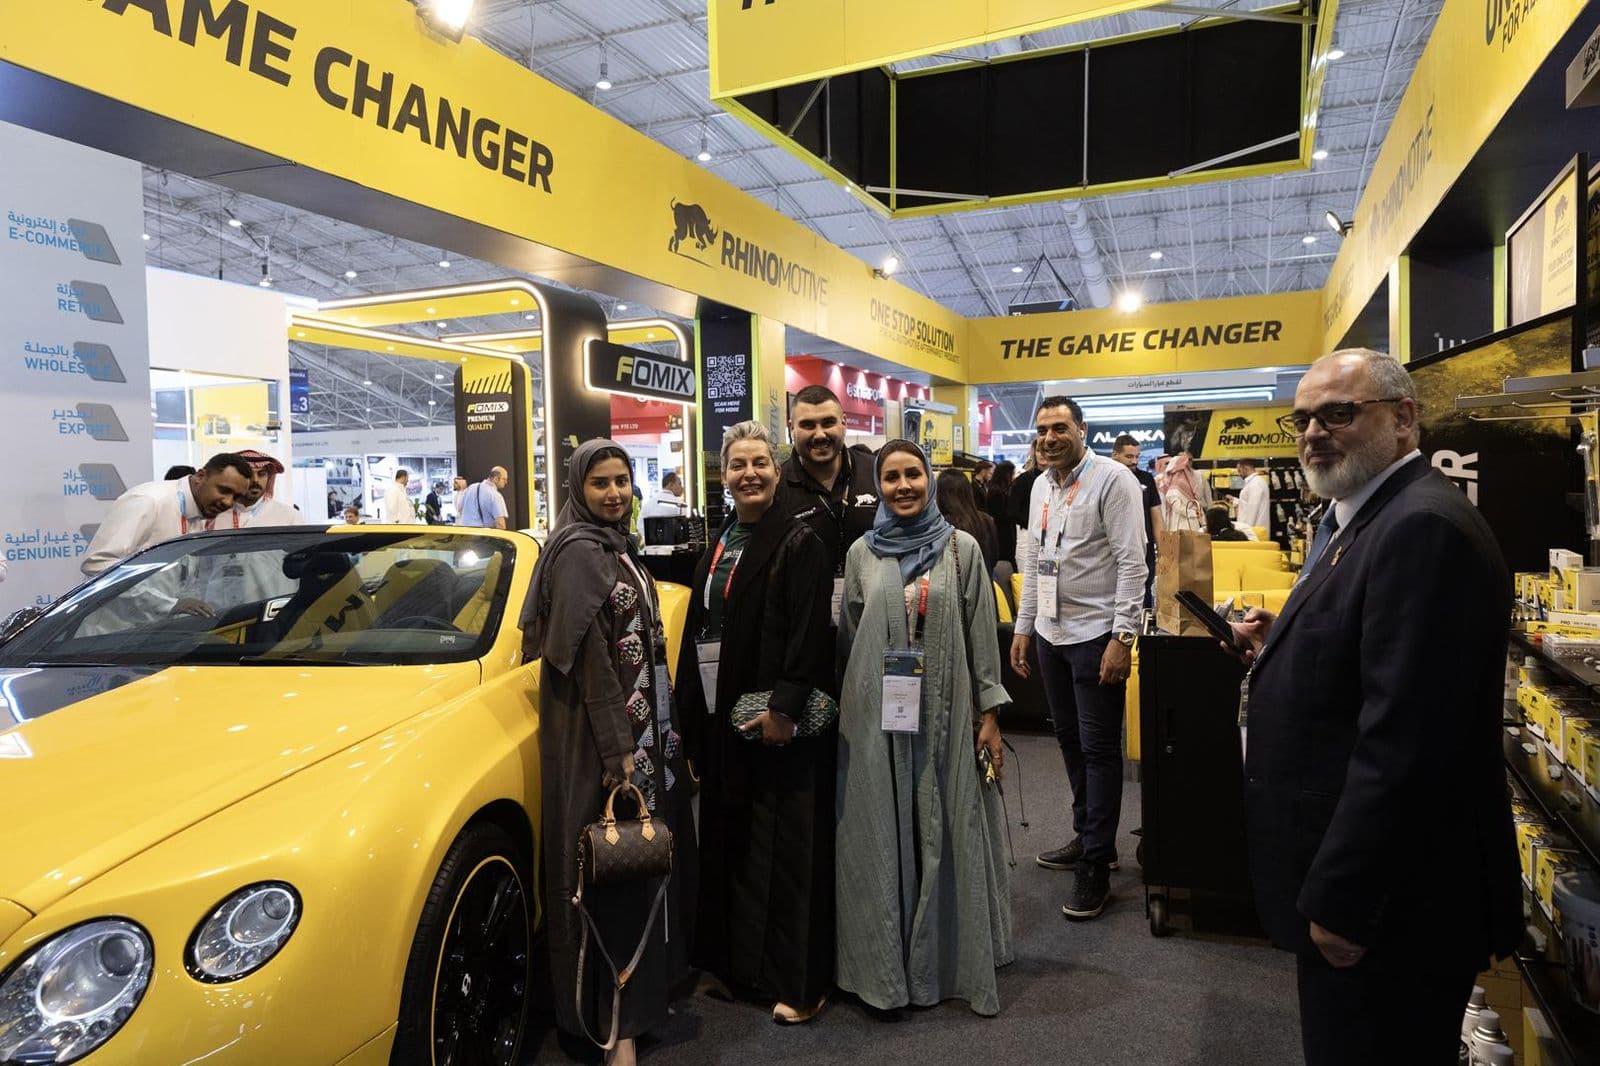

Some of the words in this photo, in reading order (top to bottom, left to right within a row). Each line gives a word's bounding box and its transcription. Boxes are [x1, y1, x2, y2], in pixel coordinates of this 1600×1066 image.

[87, 0, 297, 87] AME
[313, 46, 554, 194] CHANGER
[721, 230, 828, 306] RHINOMOTIVE
[870, 298, 891, 327] ONE
[892, 309, 916, 337] STOP
[917, 320, 955, 353] SOLUTION
[1000, 337, 1053, 360] THE
[1057, 331, 1136, 357] GAME
[1143, 319, 1283, 351] CHANGER
[616, 355, 691, 394] FOMIX
[299, 397, 308, 411] 3
[467, 402, 507, 414] FOMIX
[467, 423, 493, 431] QUALITY
[1431, 449, 1478, 507] R
[6, 545, 71, 561] GENUINE
